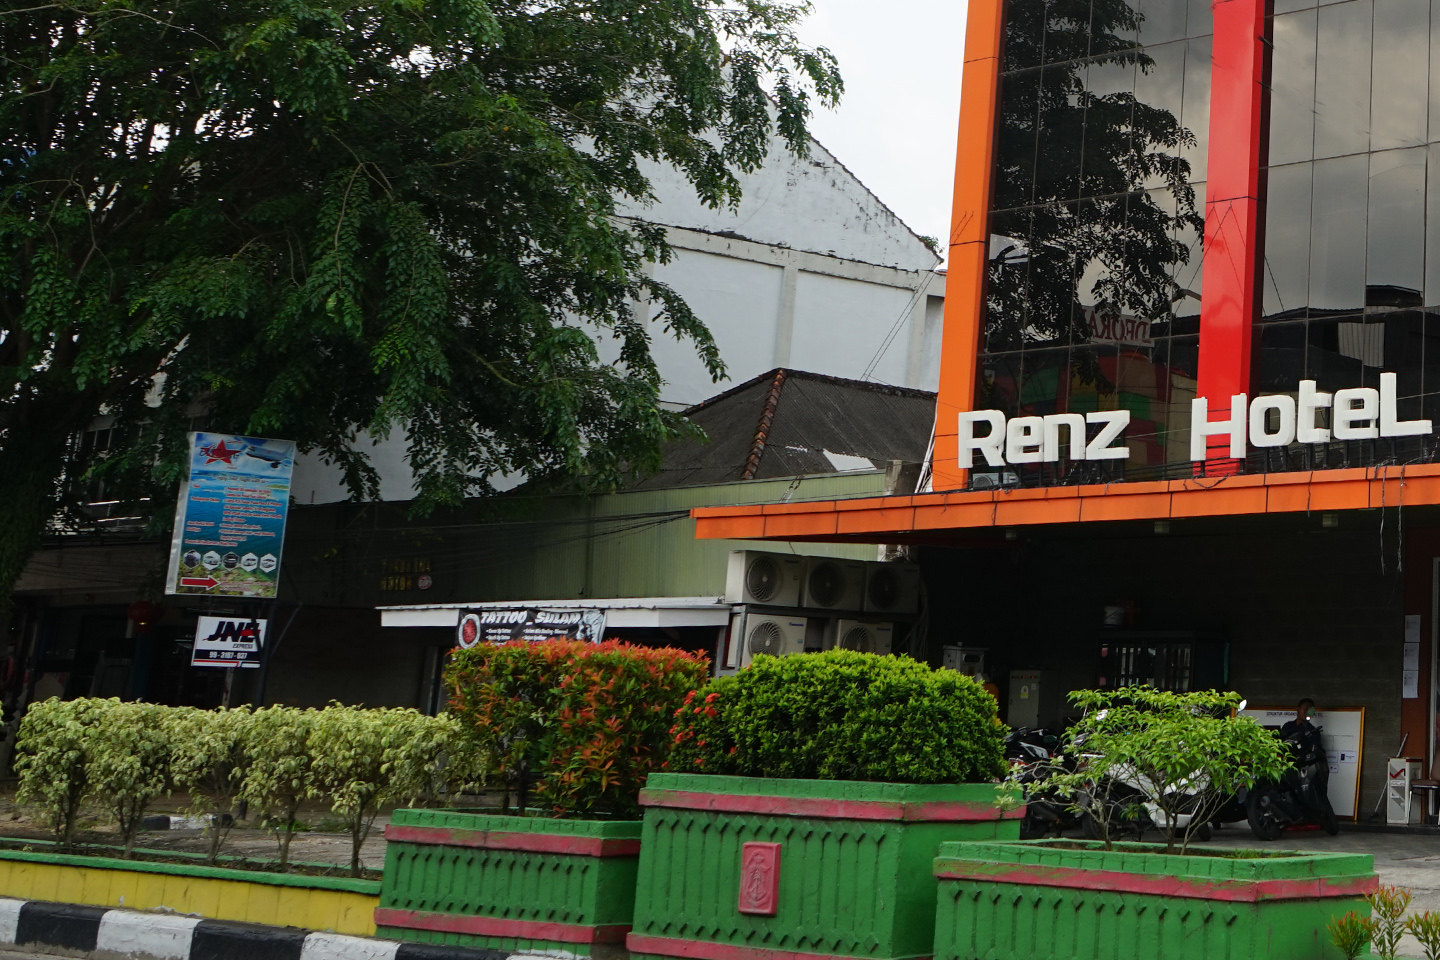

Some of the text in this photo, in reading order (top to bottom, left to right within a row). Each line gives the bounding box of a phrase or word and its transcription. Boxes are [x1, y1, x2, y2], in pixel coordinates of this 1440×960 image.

[958, 409, 1130, 469] Renz
[534, 611, 583, 625] SULAM
[203, 620, 261, 643] JNE
